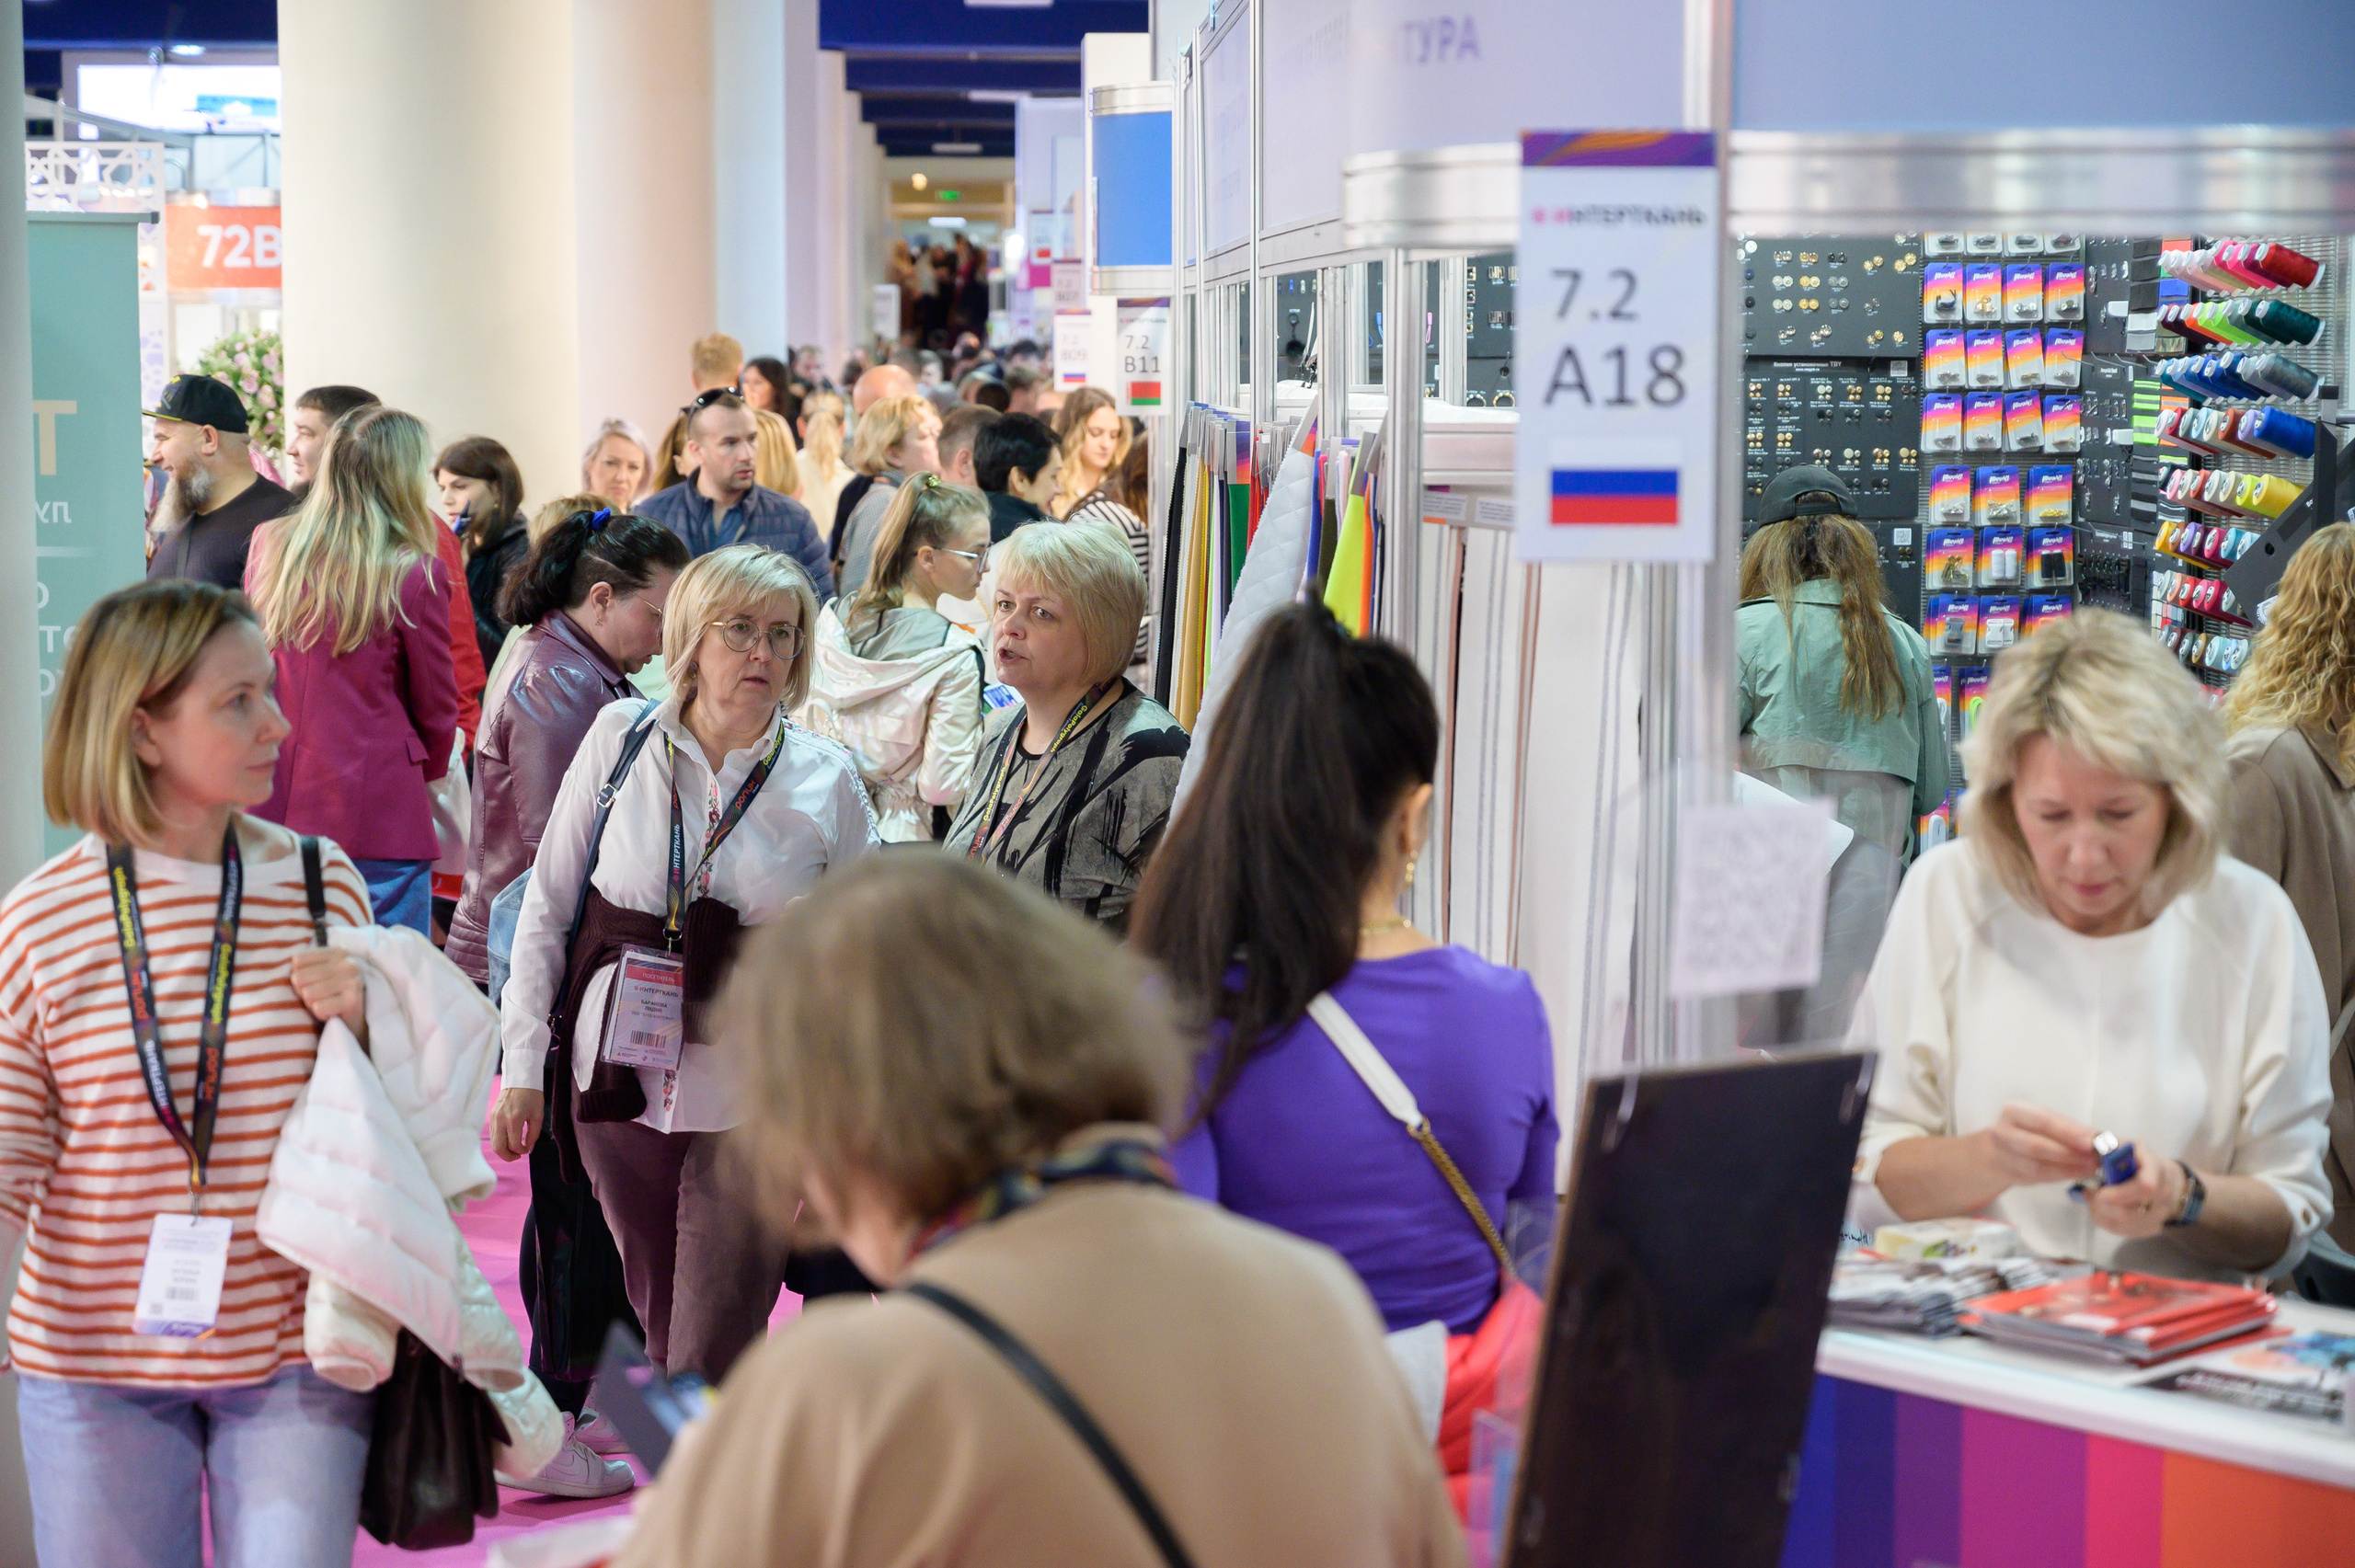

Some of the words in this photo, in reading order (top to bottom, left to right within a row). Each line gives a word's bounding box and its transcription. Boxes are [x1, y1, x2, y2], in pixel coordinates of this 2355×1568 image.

[1551, 268, 1638, 320] 7.2
[1124, 355, 1161, 372] B11
[1125, 335, 1149, 349] 7.2
[1543, 342, 1686, 407] A18
[1050, 704, 1088, 753] GalaPolygraph
[983, 766, 1006, 821] GalaPolygraph
[672, 823, 681, 875] ИНТЕРТКАНЬ
[638, 986, 679, 998] ИНТЕРТКАНЬ
[642, 972, 675, 983] ПОСЕТИТЕЛЬ
